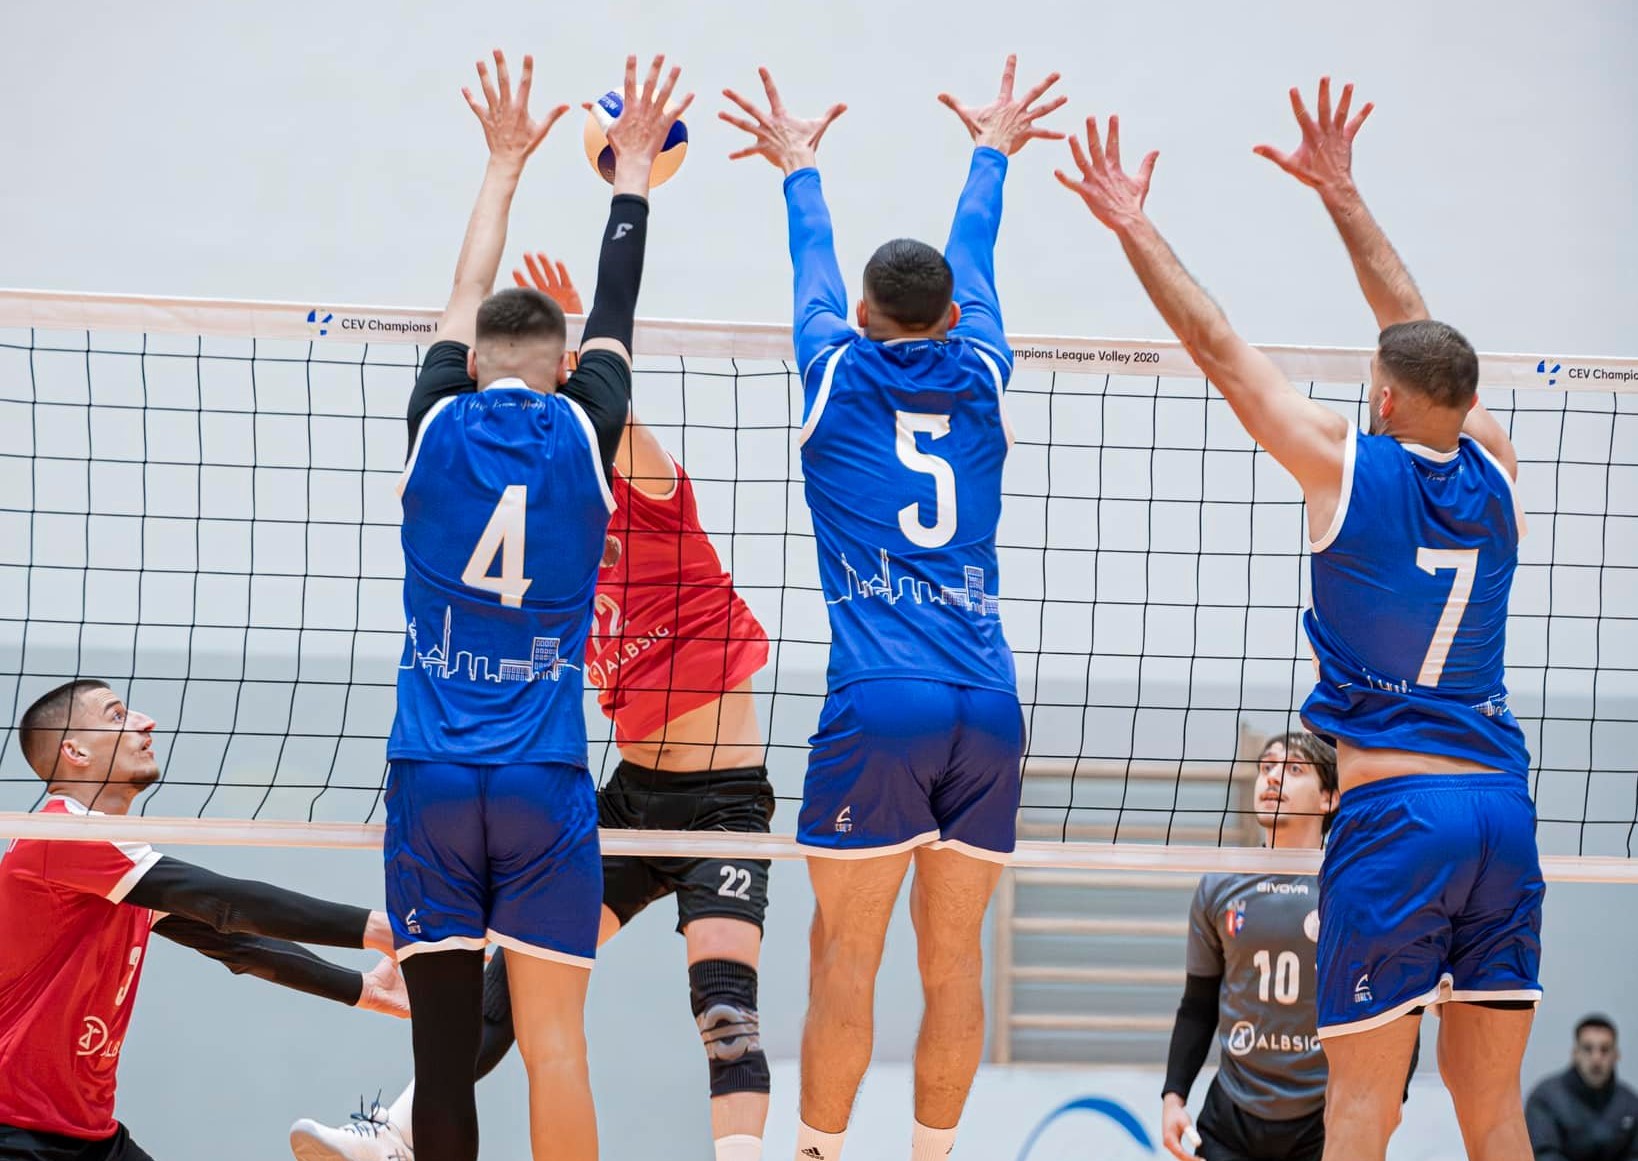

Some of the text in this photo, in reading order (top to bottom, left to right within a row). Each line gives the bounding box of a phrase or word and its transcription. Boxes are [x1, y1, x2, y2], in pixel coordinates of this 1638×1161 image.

[341, 318, 366, 330] CEV
[368, 319, 432, 333] Champions
[1014, 347, 1160, 364] mpions League Volley 2020
[1568, 368, 1638, 382] CEV Champio
[896, 405, 957, 548] 5
[461, 485, 533, 608] 4
[592, 593, 630, 656] 2
[1416, 547, 1479, 688] 7
[605, 624, 670, 675] ALBSIG
[718, 865, 751, 901] 22
[1253, 950, 1300, 1005] 10
